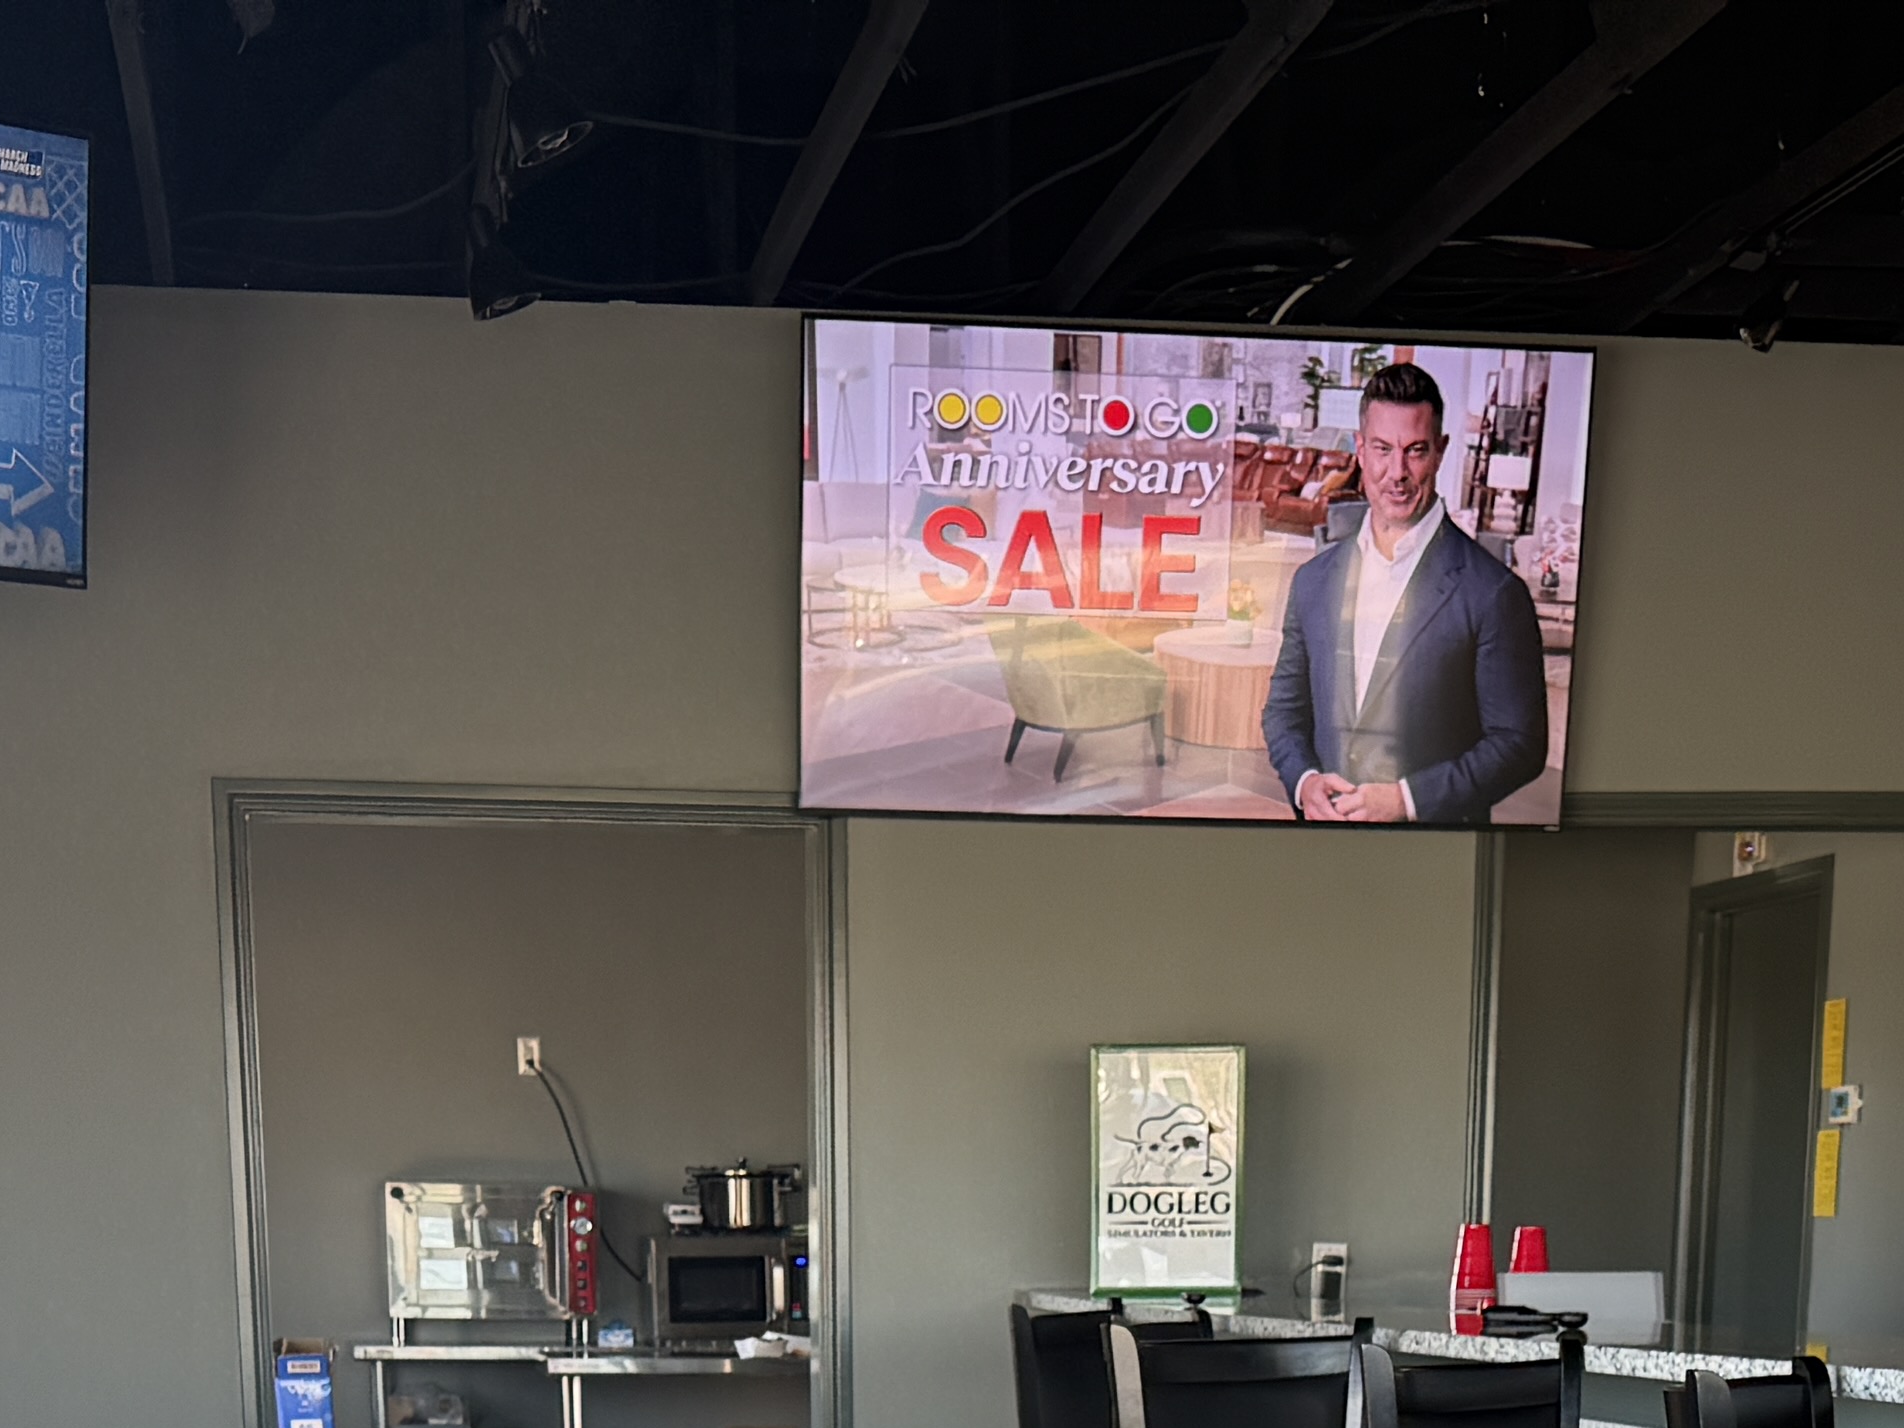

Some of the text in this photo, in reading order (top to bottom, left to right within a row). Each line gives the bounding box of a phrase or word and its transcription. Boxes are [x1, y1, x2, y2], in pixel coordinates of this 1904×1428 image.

[0, 159, 43, 177] MADNESS
[907, 386, 1219, 440] ROOMS TO GO
[894, 441, 1225, 508] Anniversary
[919, 505, 1201, 613] SALE
[1107, 1191, 1231, 1215] DOGLEG
